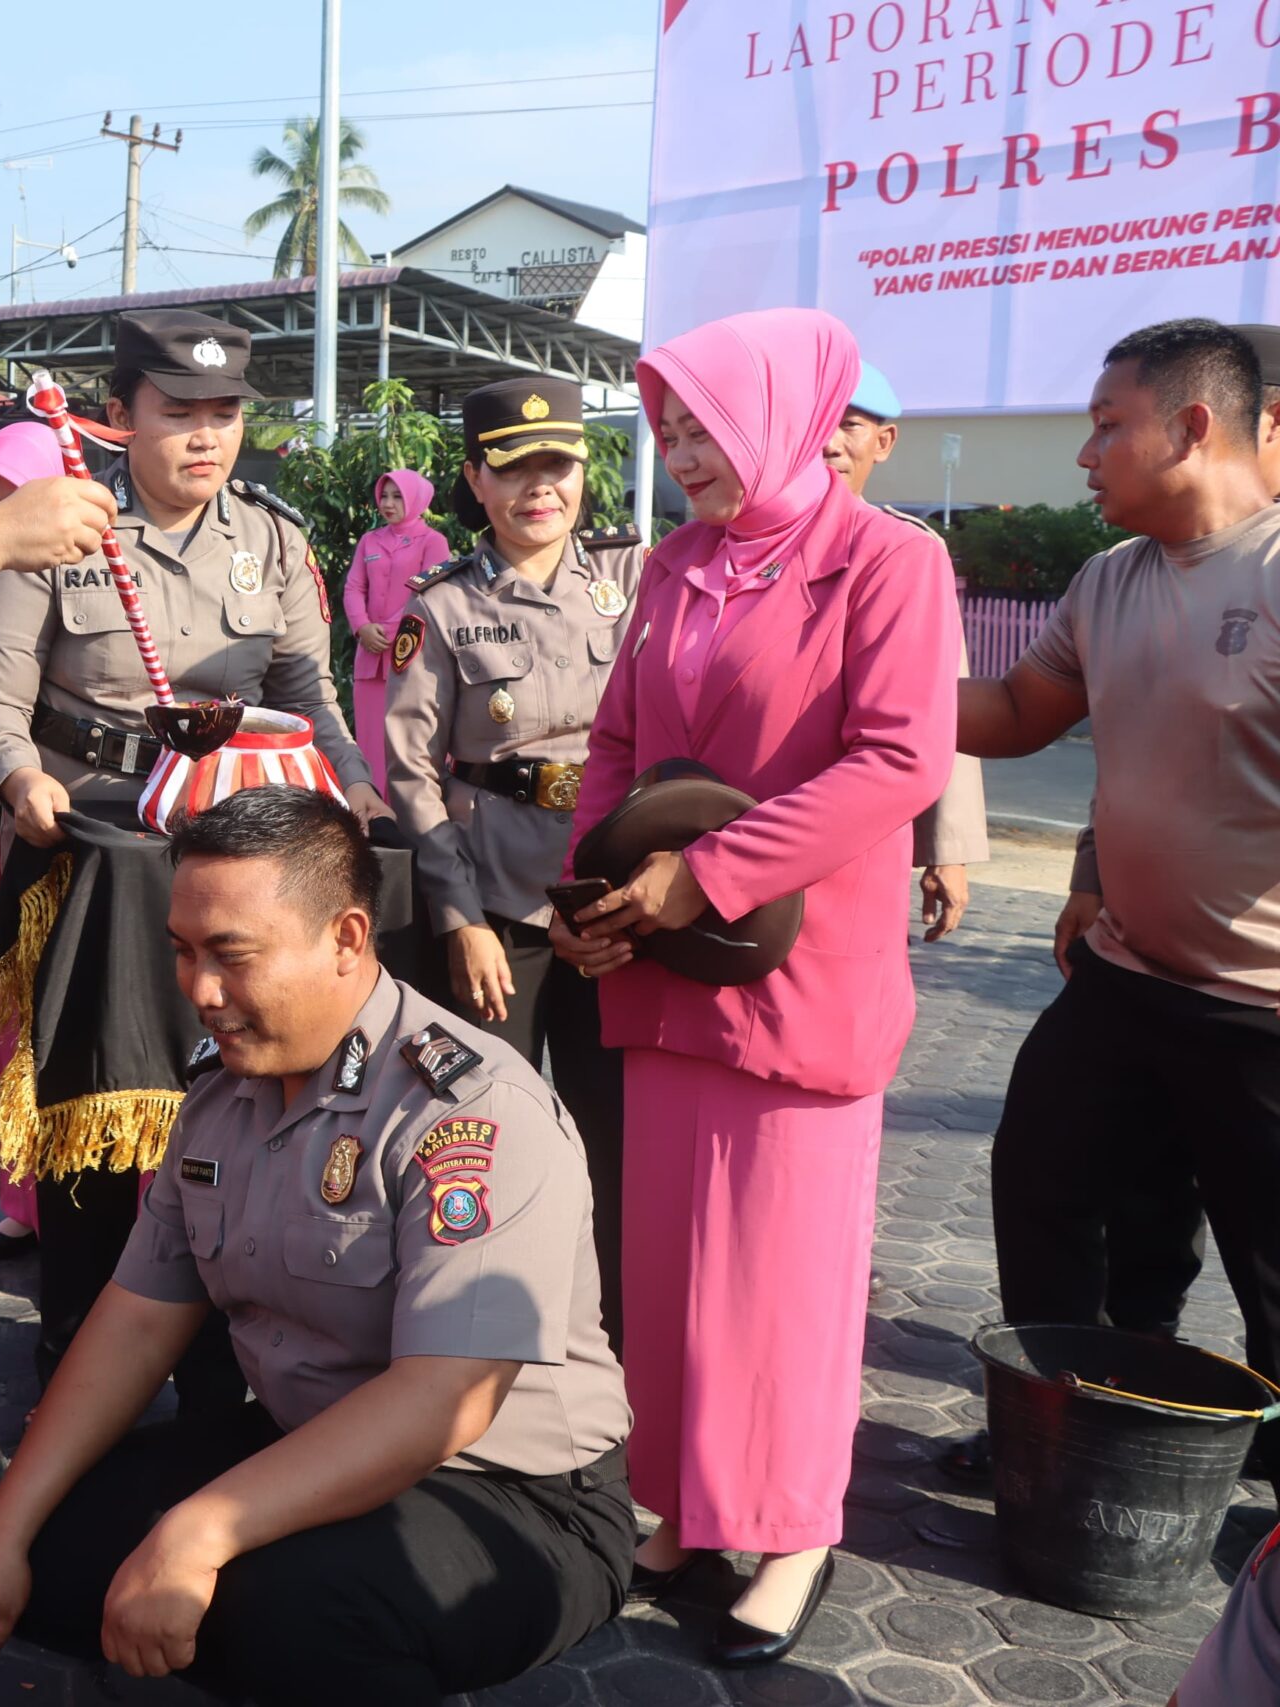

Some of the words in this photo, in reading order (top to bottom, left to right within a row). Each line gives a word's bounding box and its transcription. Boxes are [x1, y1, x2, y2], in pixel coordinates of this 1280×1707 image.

[868, 4, 1215, 120] PERIODE
[821, 109, 1181, 213] POLRES
[451, 247, 487, 262] RESTO
[521, 245, 596, 268] CALLISTA
[938, 233, 1031, 262] PRESISI
[1033, 211, 1209, 252] MENDUKUNG
[873, 272, 934, 297] YANG
[937, 261, 1048, 291] INKLUSIF
[1050, 255, 1109, 281] DAN
[64, 568, 143, 588] RATH
[456, 622, 521, 647] ELFRIDA
[1083, 1500, 1200, 1544] ANTI
